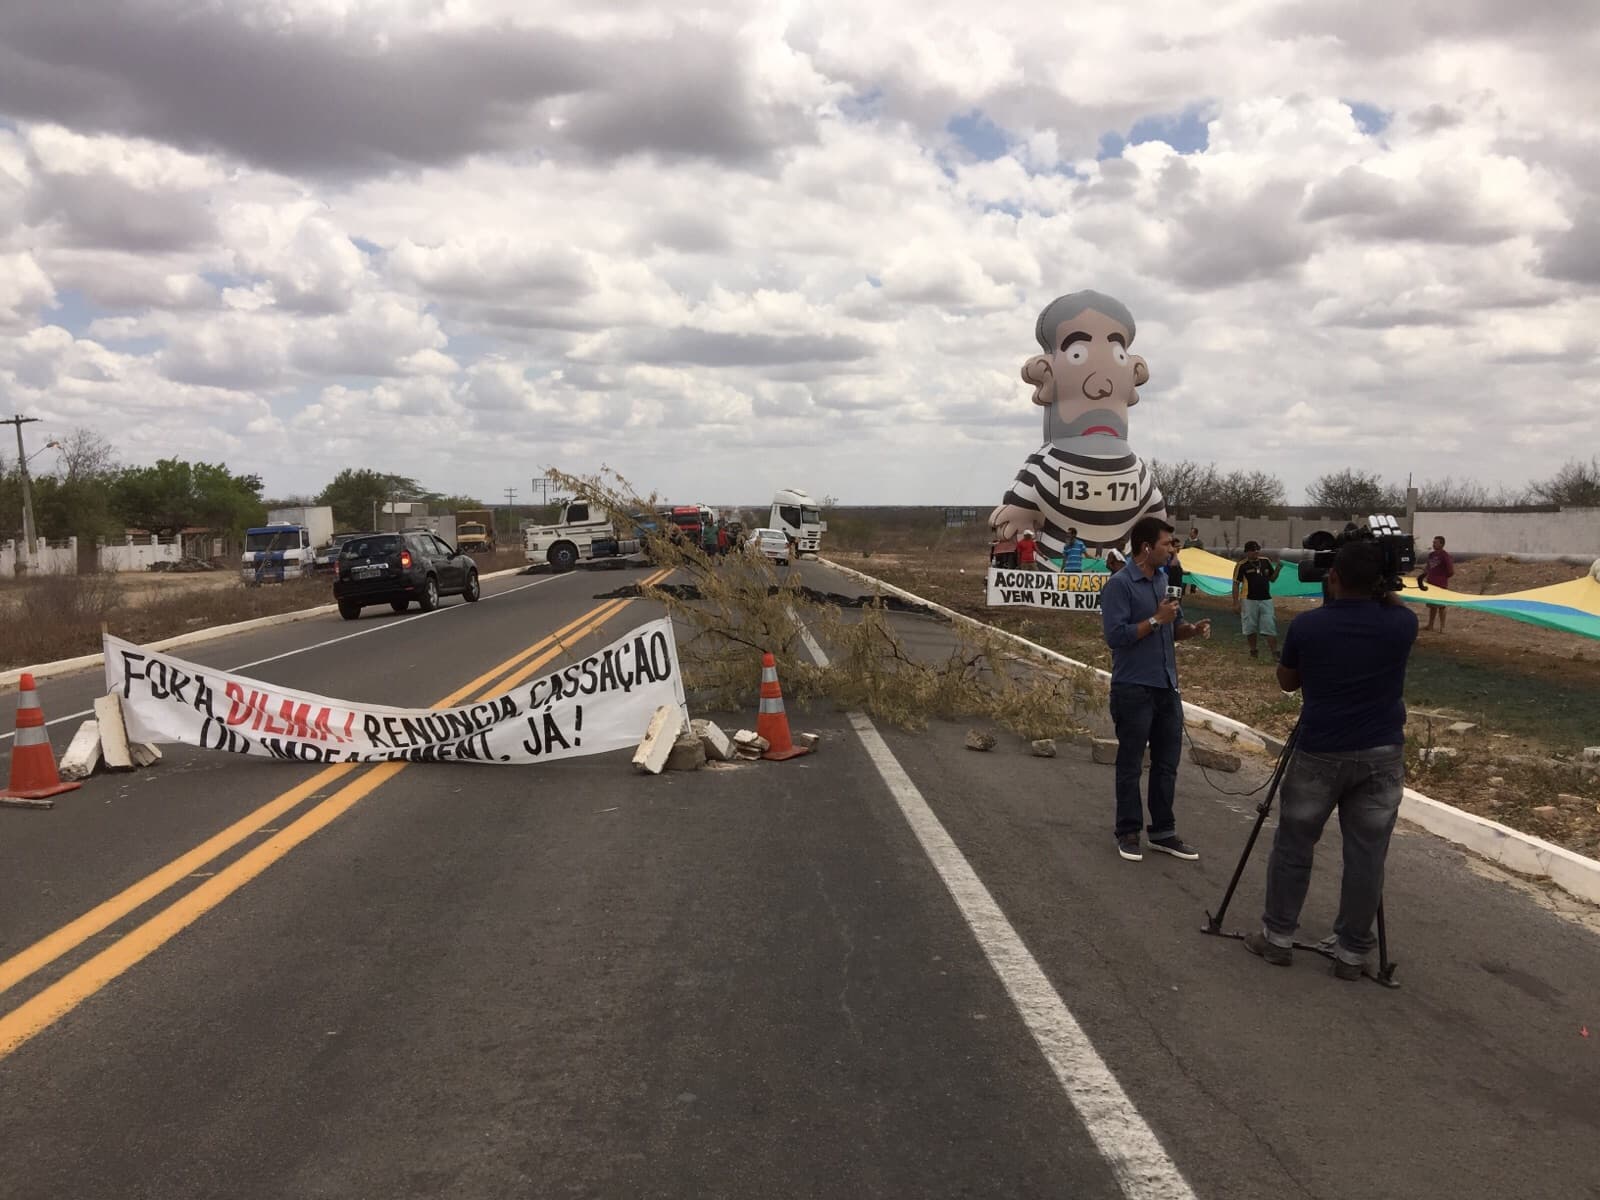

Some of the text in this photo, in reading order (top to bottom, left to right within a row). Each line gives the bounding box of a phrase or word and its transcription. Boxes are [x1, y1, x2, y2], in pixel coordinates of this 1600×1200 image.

[1062, 481, 1089, 500] 13
[1107, 482, 1137, 501] 171
[994, 572, 1108, 592] ACORDA BRASI
[1000, 590, 1035, 604] VEM
[1040, 592, 1070, 608] PRA
[225, 682, 355, 743] DILMA!
[530, 631, 672, 710] CASSAÇÃO
